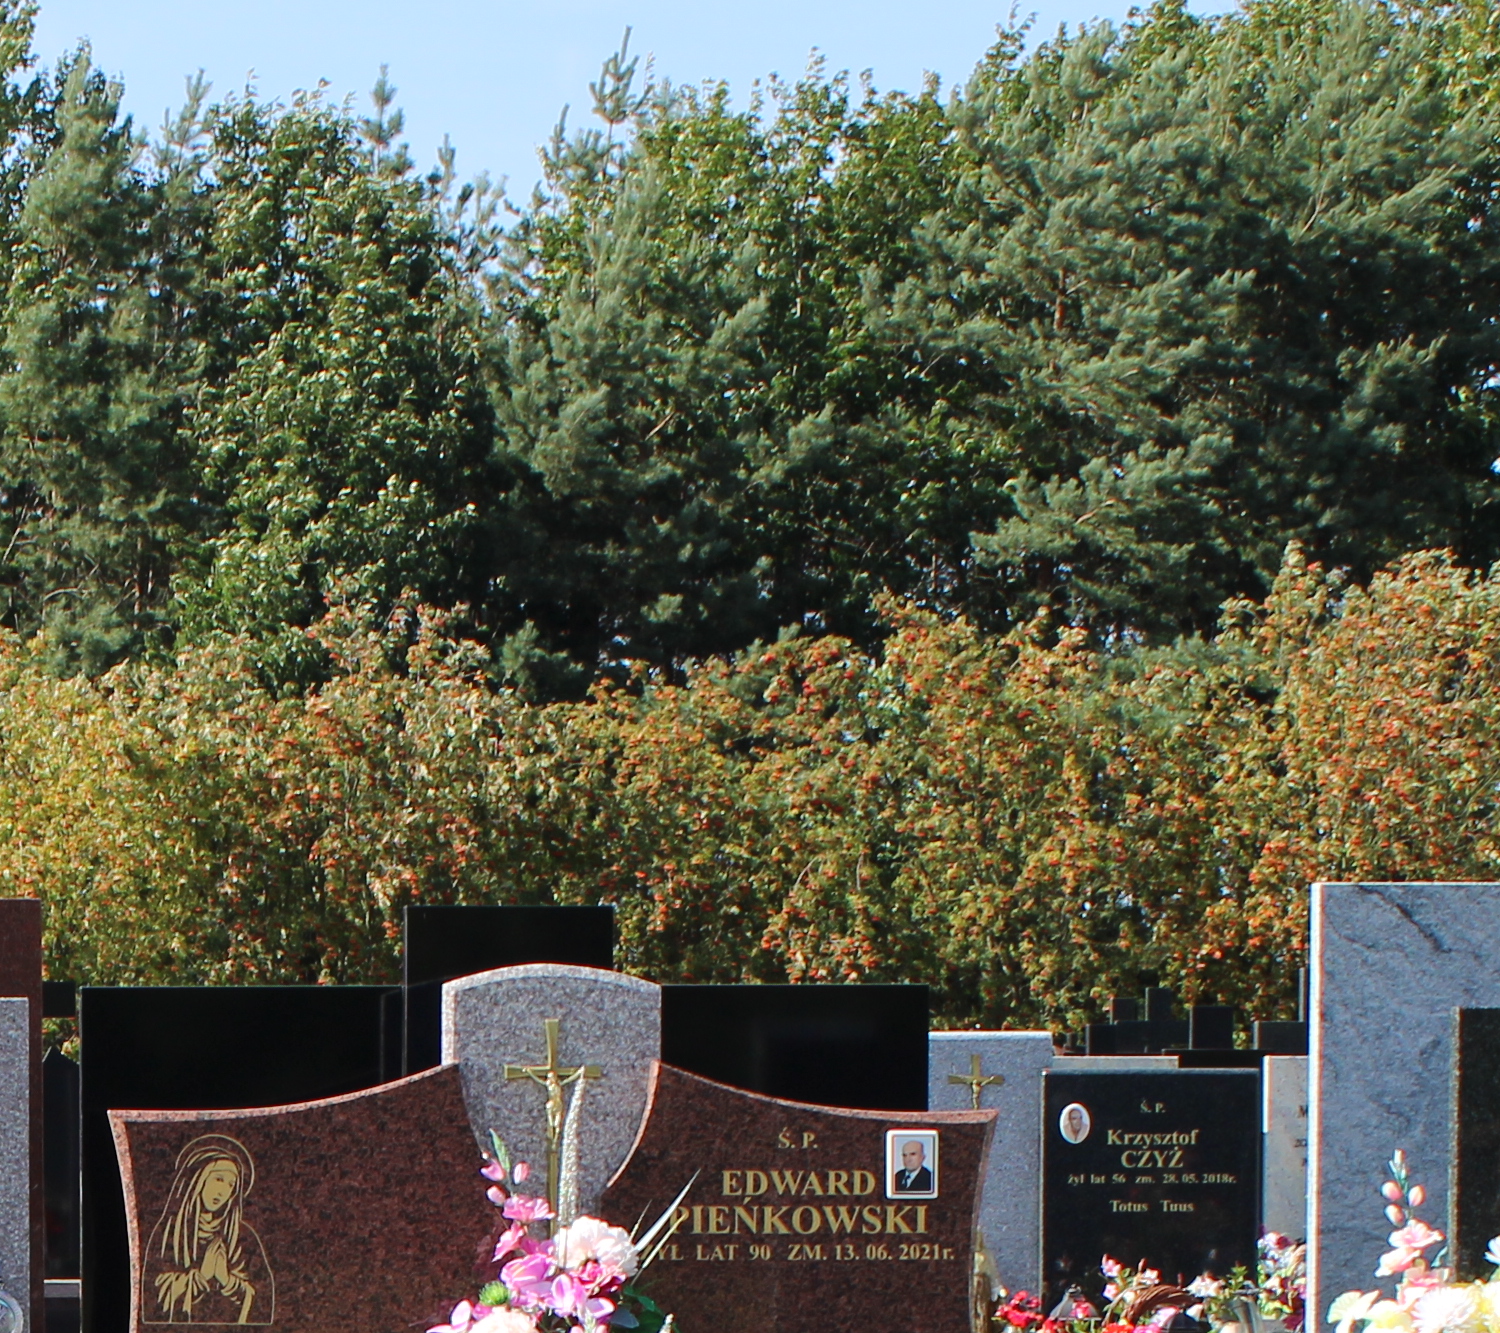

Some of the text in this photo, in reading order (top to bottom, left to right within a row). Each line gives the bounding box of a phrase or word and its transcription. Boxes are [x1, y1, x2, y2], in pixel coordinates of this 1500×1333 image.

[1107, 1129, 1199, 1149] Krzysztof
[1121, 1146, 1185, 1168] CZYŻ
[722, 1169, 876, 1196] EDWARD
[669, 1198, 929, 1235] PIEŃKOWSKI
[697, 1244, 736, 1261] LAT
[749, 1244, 770, 1261] 90
[788, 1244, 828, 1261] ZM.
[834, 1244, 860, 1261] 13.
[866, 1244, 892, 1261] 06.
[899, 1244, 955, 1261] 2021r.
